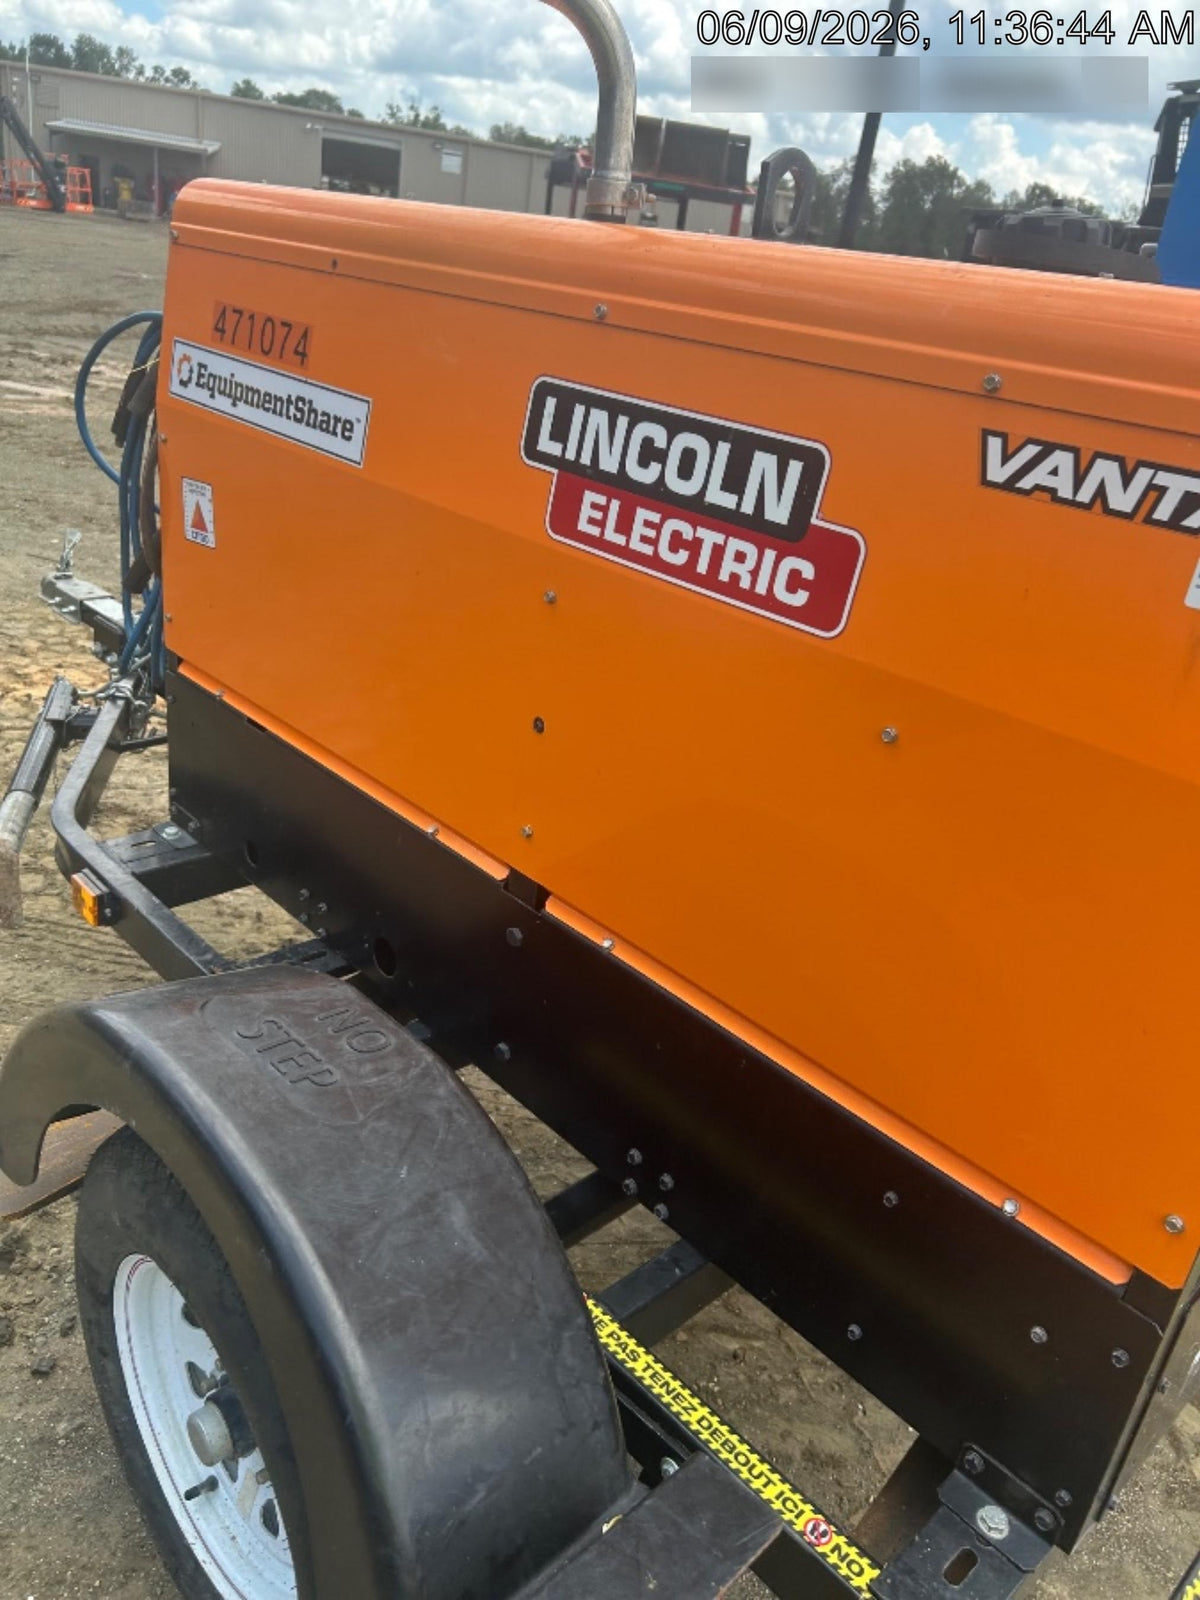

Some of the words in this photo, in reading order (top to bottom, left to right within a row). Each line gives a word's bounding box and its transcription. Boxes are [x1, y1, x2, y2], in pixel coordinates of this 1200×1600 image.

[213, 304, 311, 367] 471074
[536, 395, 805, 526] LINCOLN
[576, 489, 816, 608] ELECTRIC
[235, 1019, 338, 1088] STEP
[315, 1007, 392, 1054] NO
[605, 1330, 641, 1363] PAS
[641, 1360, 699, 1418] TENEZ
[696, 1415, 778, 1489] DEBOUT
[774, 1490, 806, 1519] ICI
[829, 1542, 865, 1578] NO
